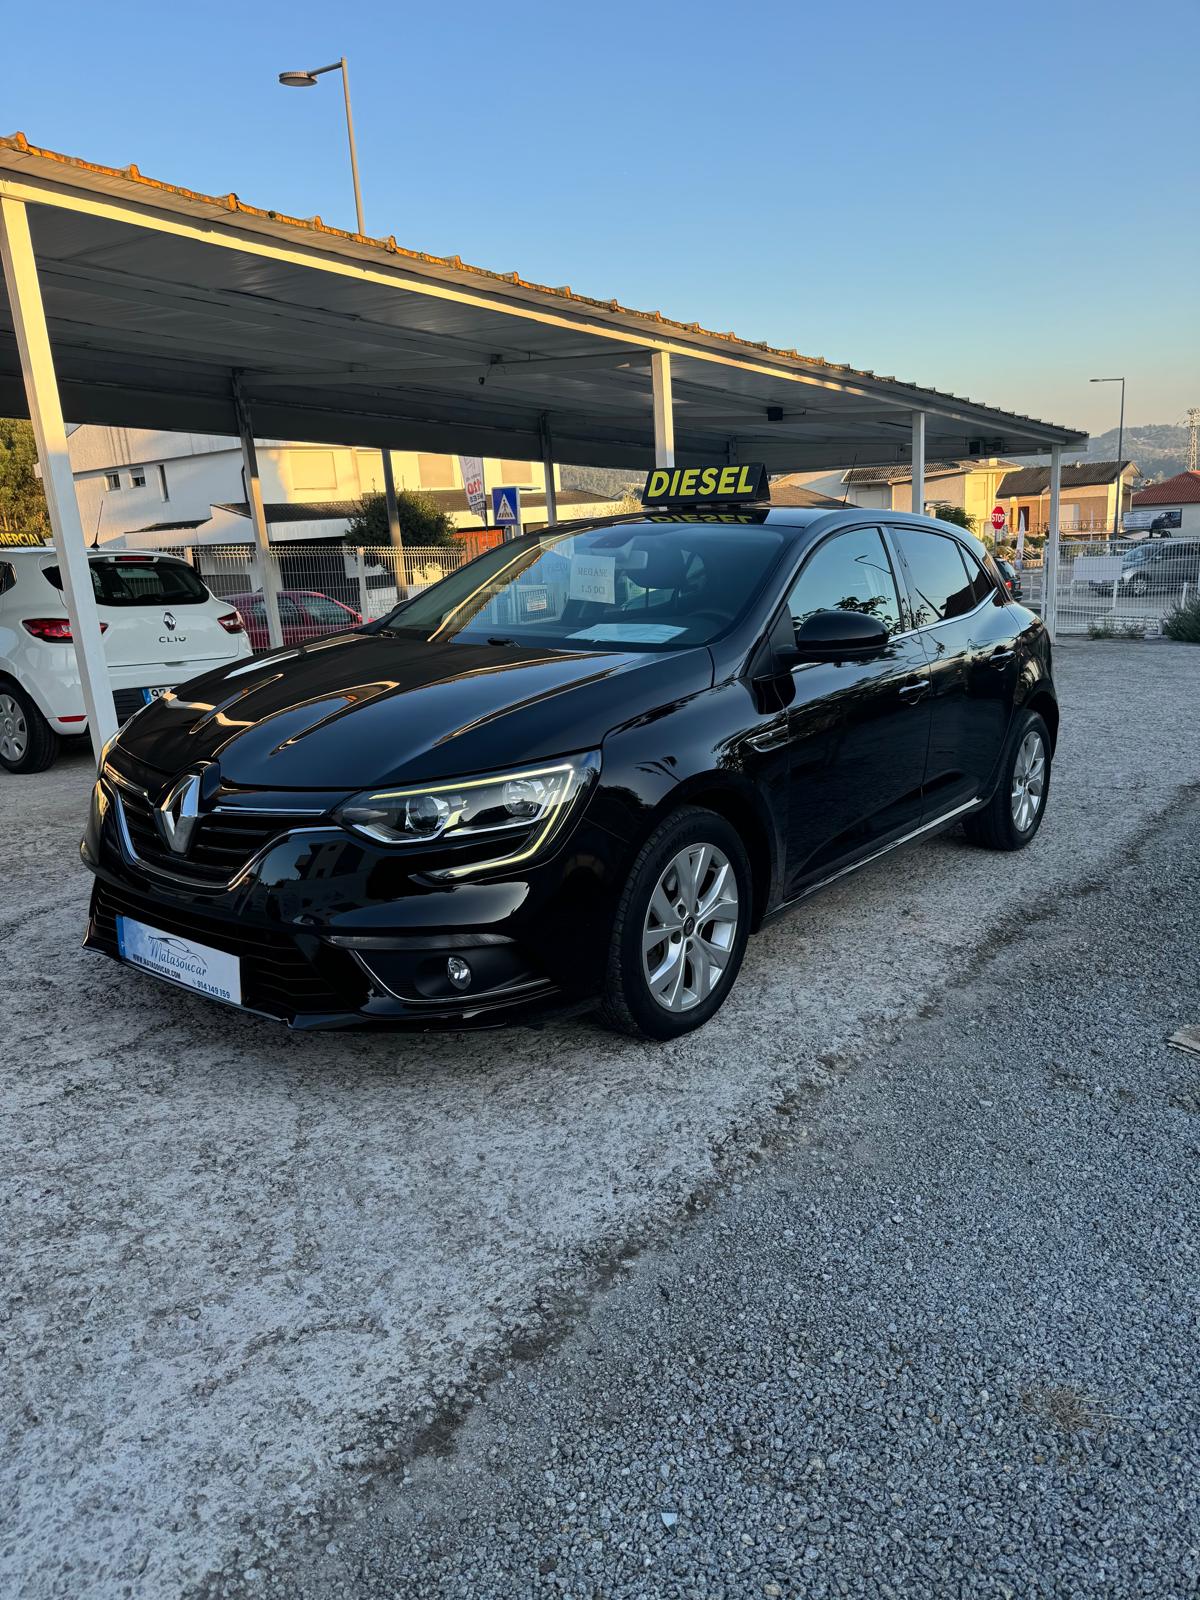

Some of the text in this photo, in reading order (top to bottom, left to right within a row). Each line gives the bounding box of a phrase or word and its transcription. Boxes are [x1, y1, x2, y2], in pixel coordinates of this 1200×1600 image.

[647, 465, 753, 497] DIESEL
[991, 513, 1005, 522] STOP
[148, 938, 207, 976] Matasoucar
